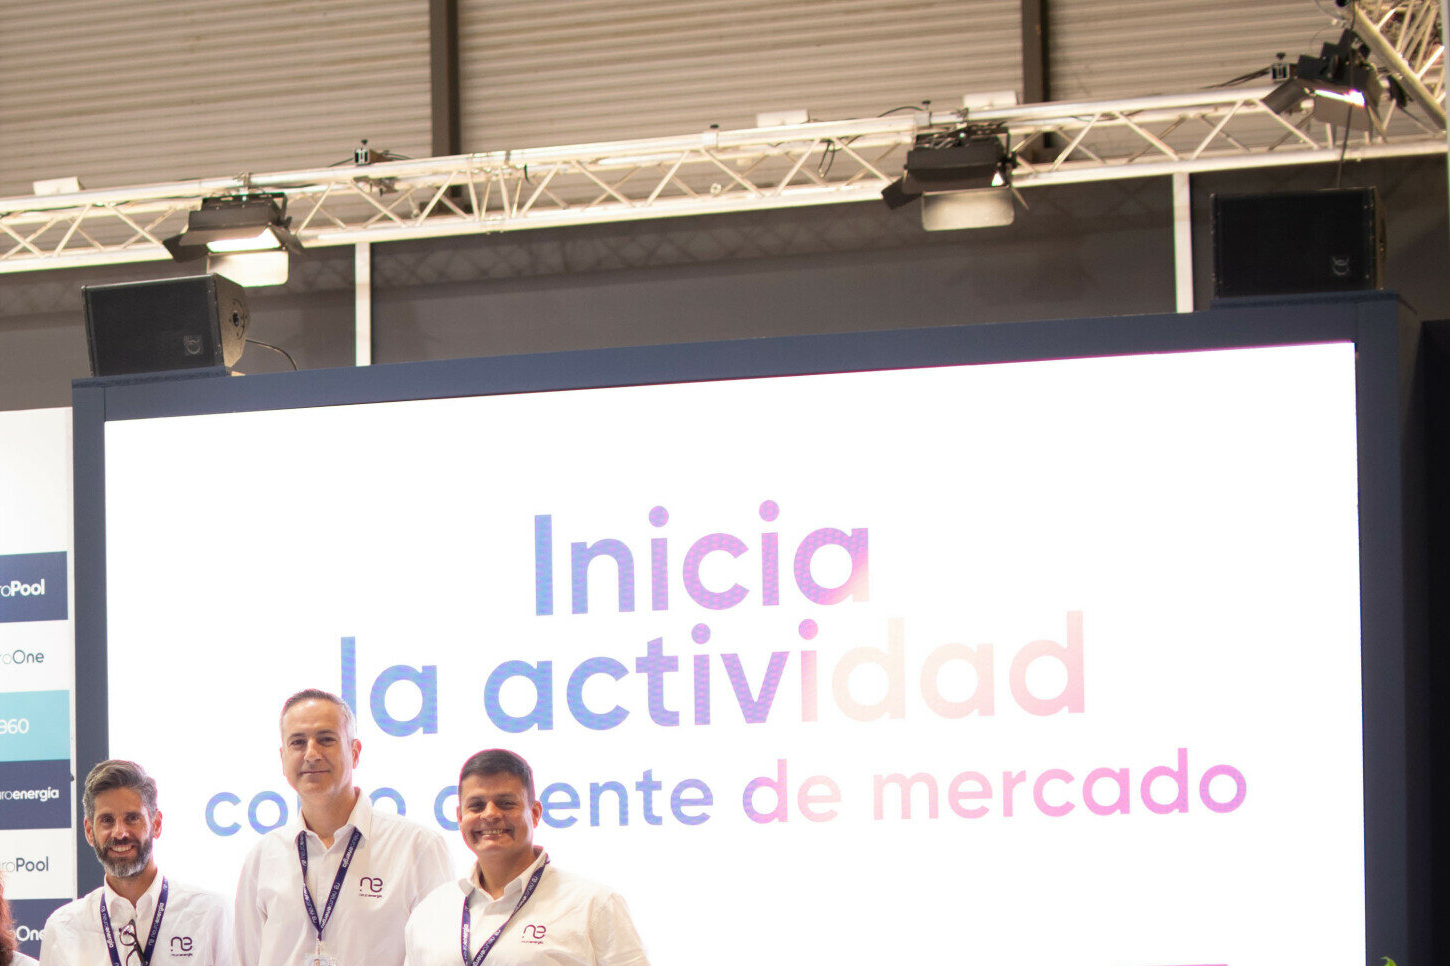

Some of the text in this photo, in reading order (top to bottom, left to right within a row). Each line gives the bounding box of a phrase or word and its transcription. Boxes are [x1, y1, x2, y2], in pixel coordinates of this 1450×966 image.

[534, 499, 869, 616] Inicia
[340, 610, 1086, 737] la actividad
[434, 768, 713, 831] ente
[742, 758, 841, 824] de
[872, 748, 1247, 824] mercado
